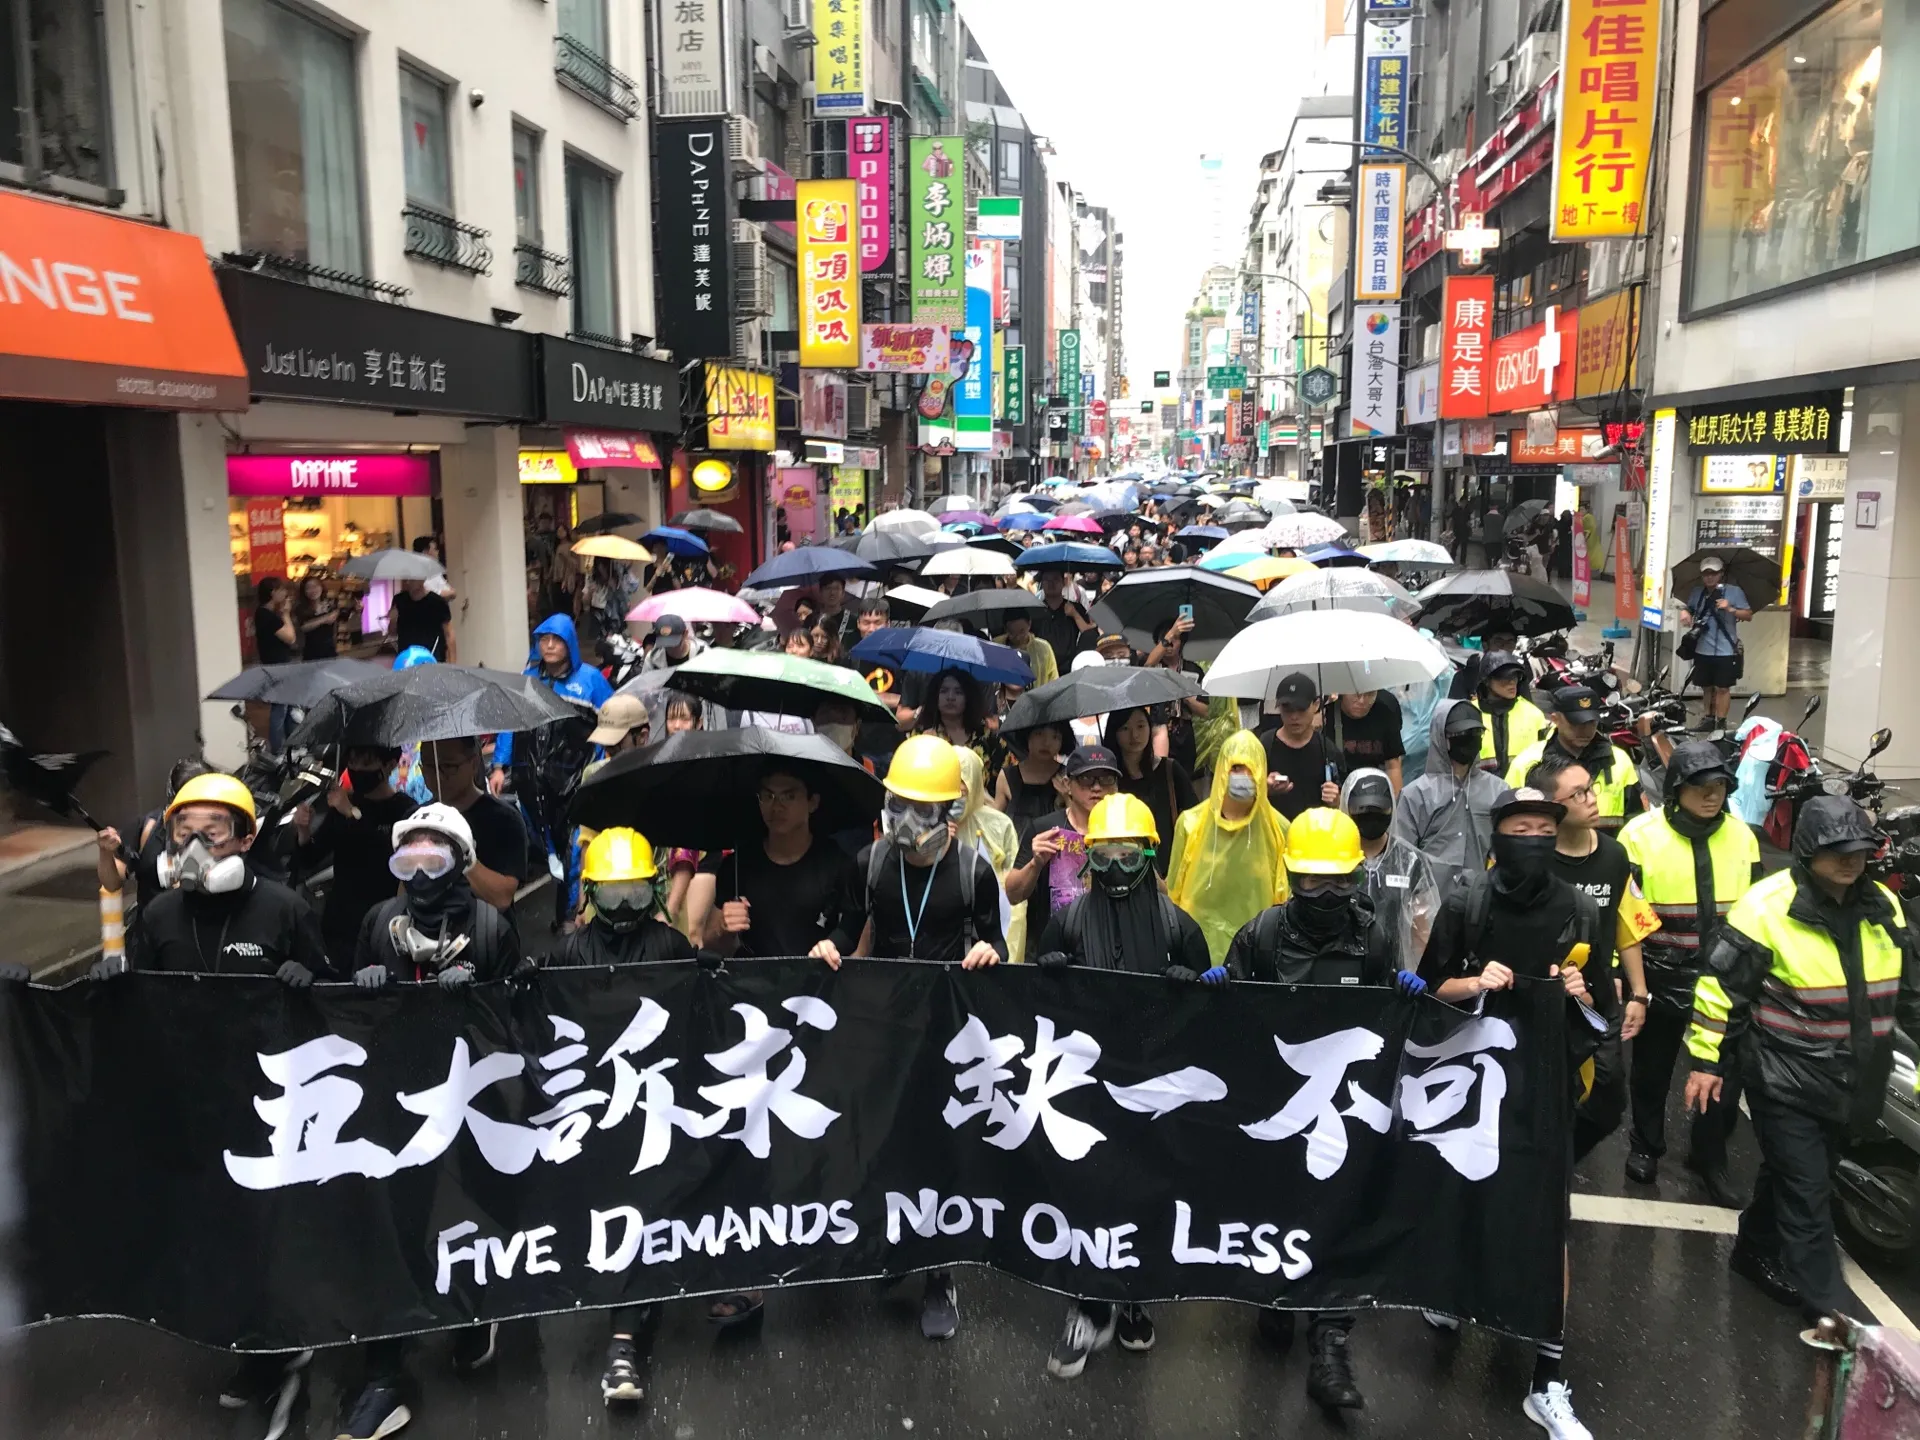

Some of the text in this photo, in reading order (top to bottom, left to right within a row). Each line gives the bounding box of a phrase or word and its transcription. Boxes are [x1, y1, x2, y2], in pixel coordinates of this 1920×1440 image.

[674, 1, 704, 52] 旅店
[673, 73, 711, 85] HOTEL
[688, 133, 715, 237] DAPHNE
[860, 160, 878, 258] phone
[1561, 201, 1639, 226] 地下一樓
[922, 181, 954, 286] 李炳輝
[1371, 172, 1391, 291] 時代國際英日語
[0, 253, 154, 324] NGE
[693, 244, 712, 311] 達芙妮
[261, 343, 356, 382] Just Live Inn
[362, 348, 447, 393] 享住旅店
[1450, 298, 1487, 396] 康是美
[1495, 345, 1540, 392] COSMED
[571, 362, 630, 407] DAPHNE
[1366, 340, 1385, 417] 台灣大哥大
[1518, 437, 1576, 456] 康是美
[1772, 405, 1830, 443] 專業教育
[290, 459, 359, 489] DAPHNE
[223, 995, 1517, 1190] 五大訴求 缺一不可
[435, 1188, 1313, 1294] FIVE DEMANDS NOT ONE LESS
